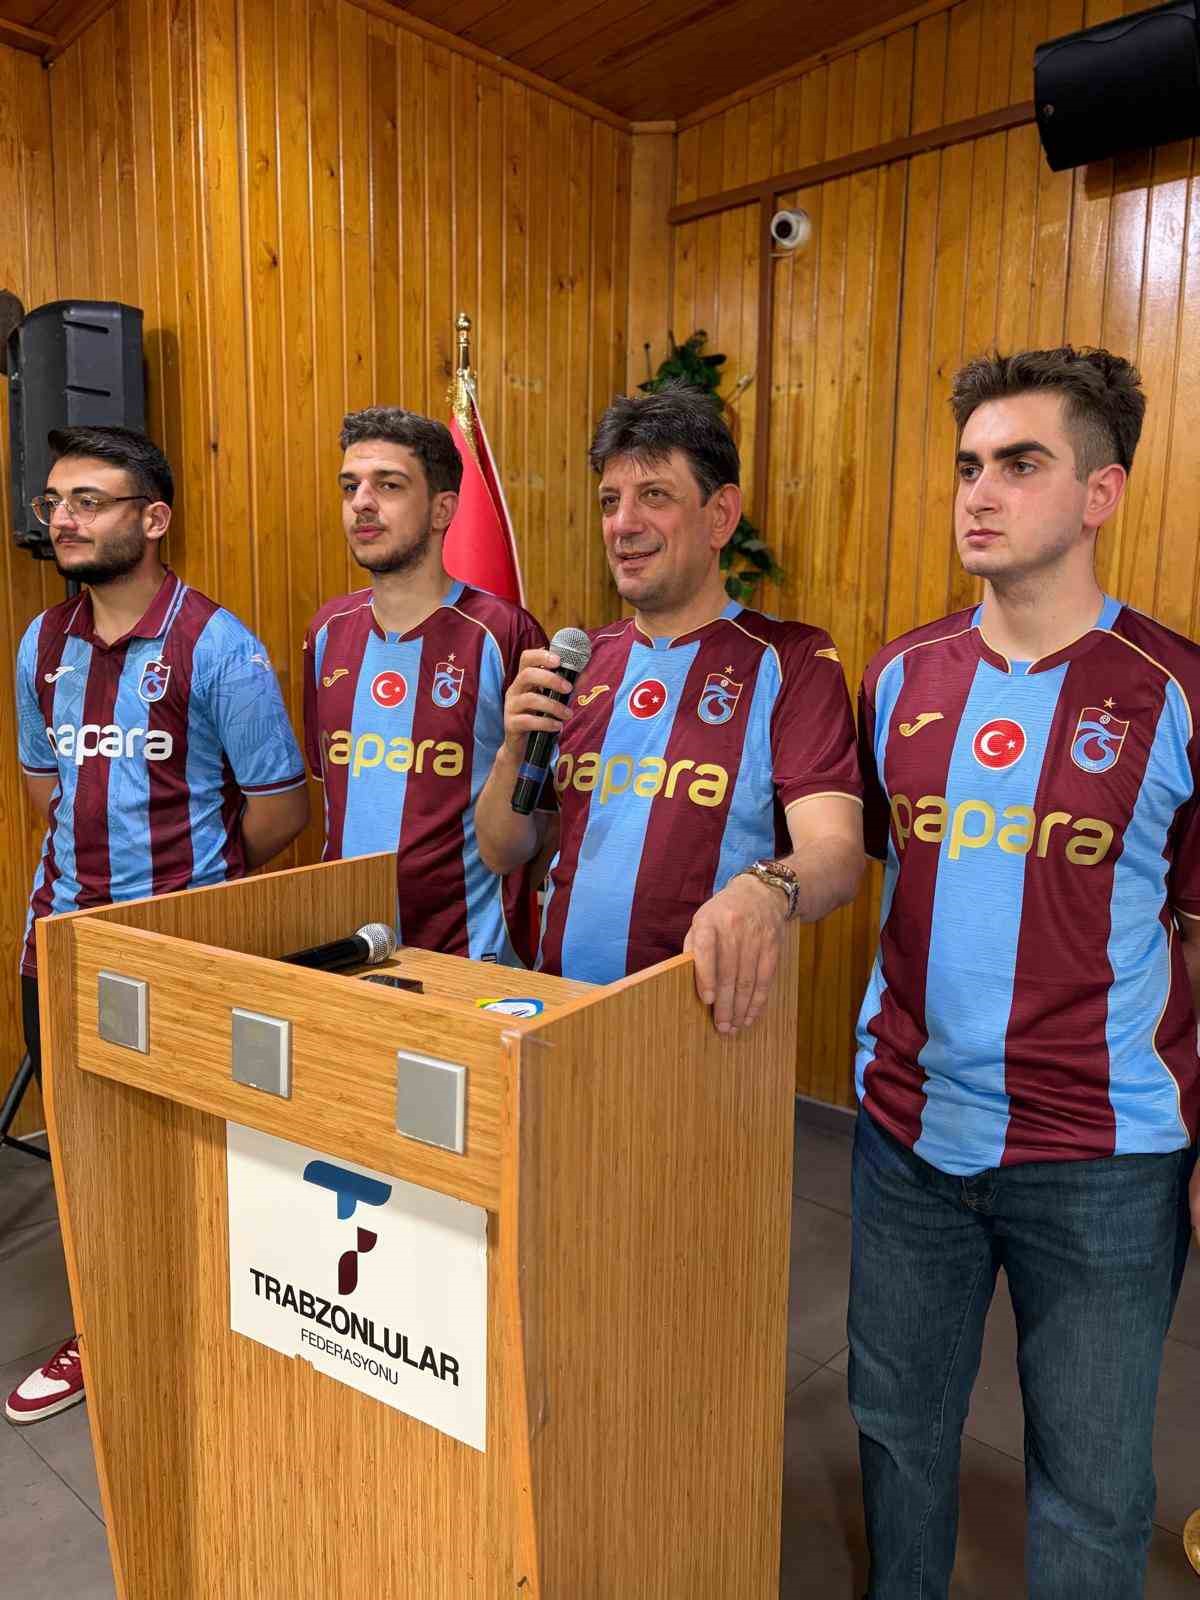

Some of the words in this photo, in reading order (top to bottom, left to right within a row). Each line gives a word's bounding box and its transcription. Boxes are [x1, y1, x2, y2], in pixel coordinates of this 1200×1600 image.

[891, 794, 1114, 866] papara
[250, 1267, 459, 1386] TRABZONLULAR
[301, 1328, 398, 1385] FEDERASYONU
